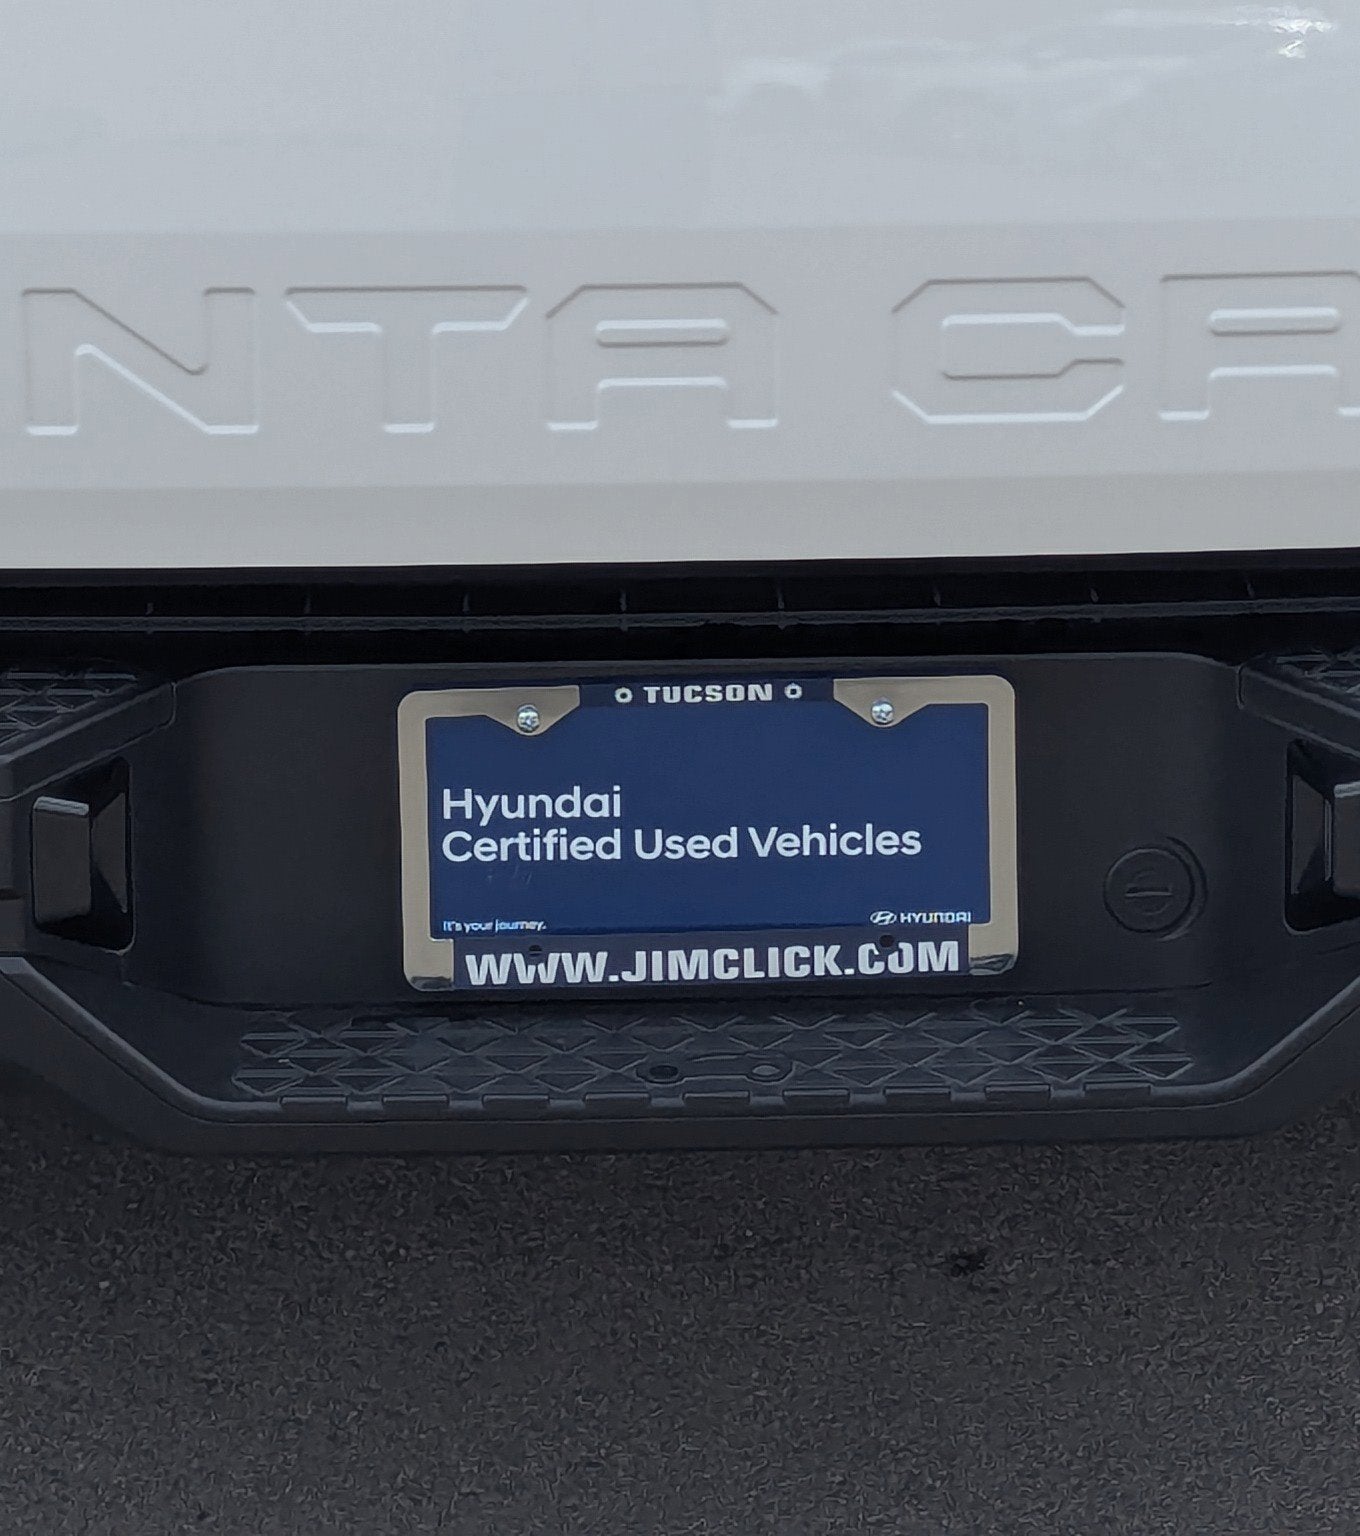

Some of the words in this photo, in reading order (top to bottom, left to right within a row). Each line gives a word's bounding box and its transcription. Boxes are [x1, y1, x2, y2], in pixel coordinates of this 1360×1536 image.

[643, 683, 773, 704] TUCSON
[442, 785, 622, 827] Hyundai
[441, 827, 622, 862] Certified
[634, 826, 739, 860] Used
[747, 822, 922, 858] Vehicles
[463, 921, 493, 934] your
[900, 911, 972, 924] HYUNDAI
[465, 940, 960, 986] WWW.JIMCLICK.COM
